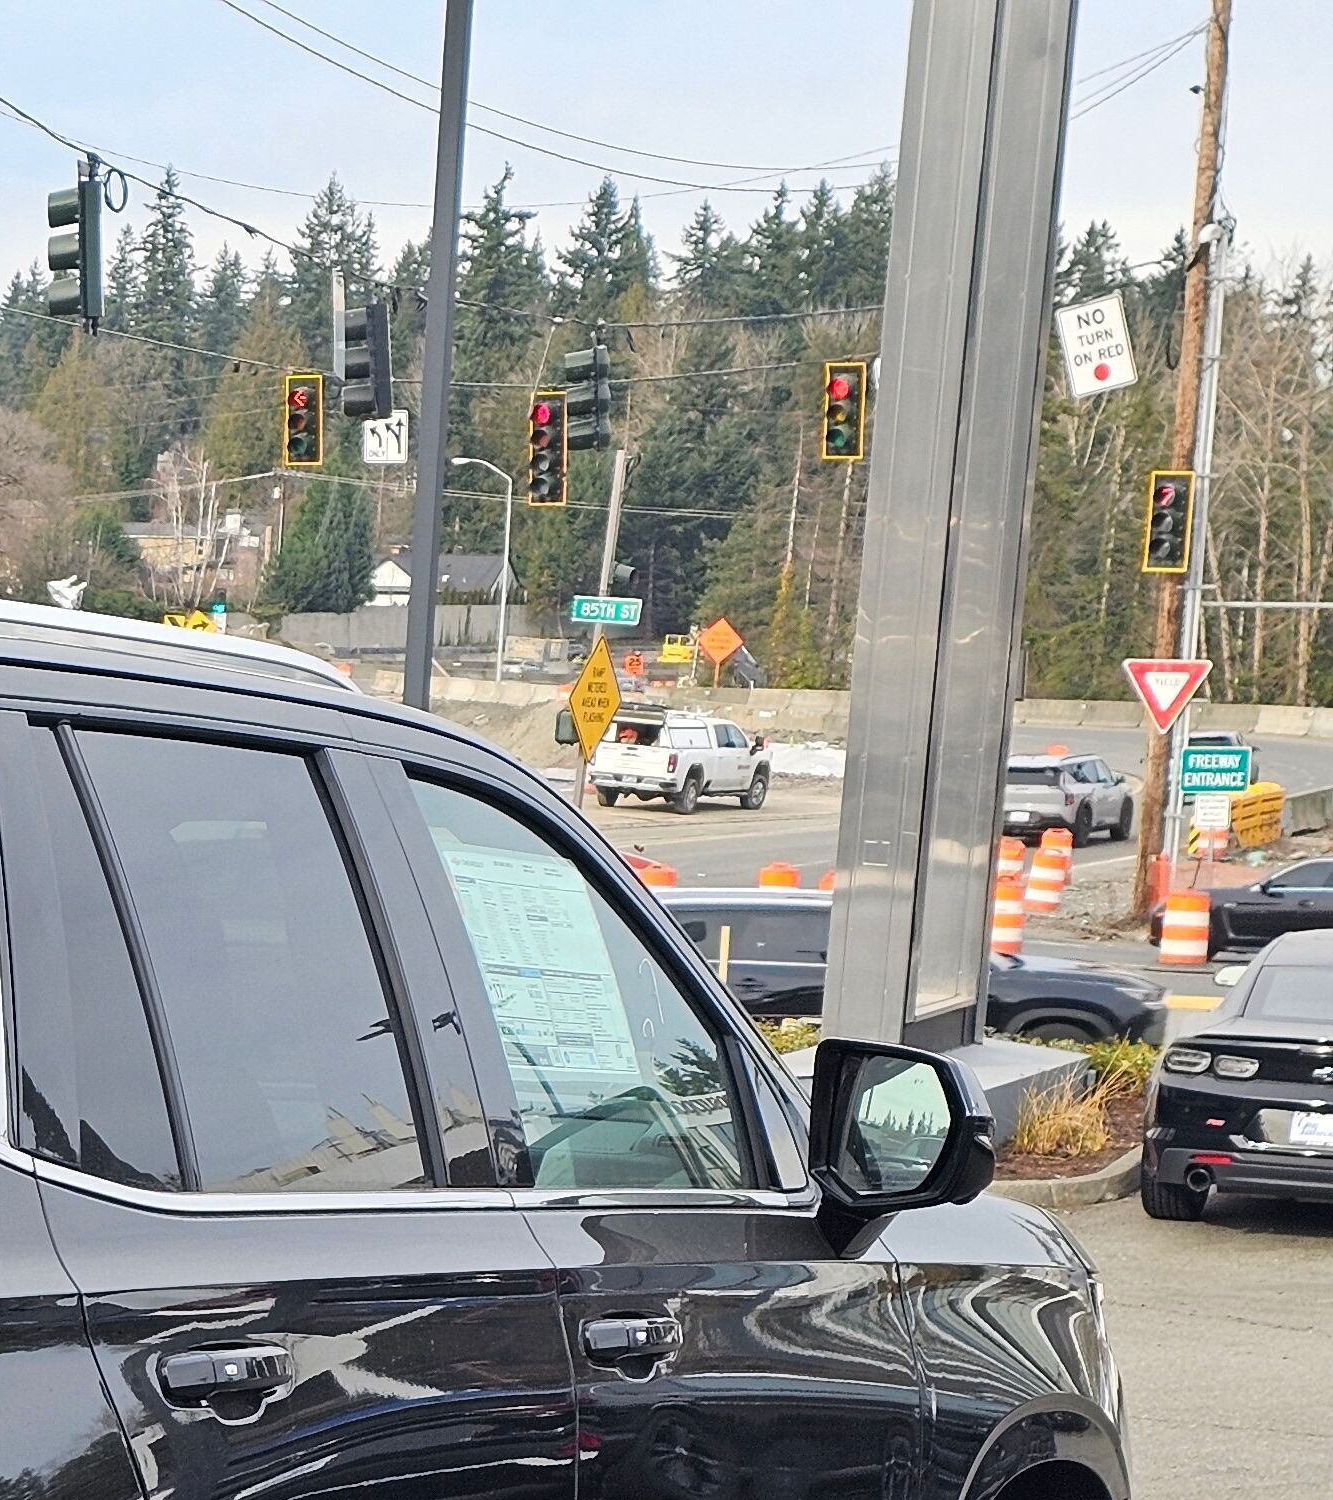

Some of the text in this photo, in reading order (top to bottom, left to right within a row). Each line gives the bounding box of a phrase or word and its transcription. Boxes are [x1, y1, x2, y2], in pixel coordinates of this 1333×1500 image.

[1076, 308, 1105, 329] NO
[1077, 328, 1114, 346] TURN
[1074, 343, 1124, 366] ON RED
[580, 602, 638, 619] 85TH ST
[628, 657, 641, 667] 25
[1155, 677, 1181, 687] YIELD
[1188, 754, 1242, 769] FREEWAY
[1184, 771, 1246, 787] ENTRANCE
